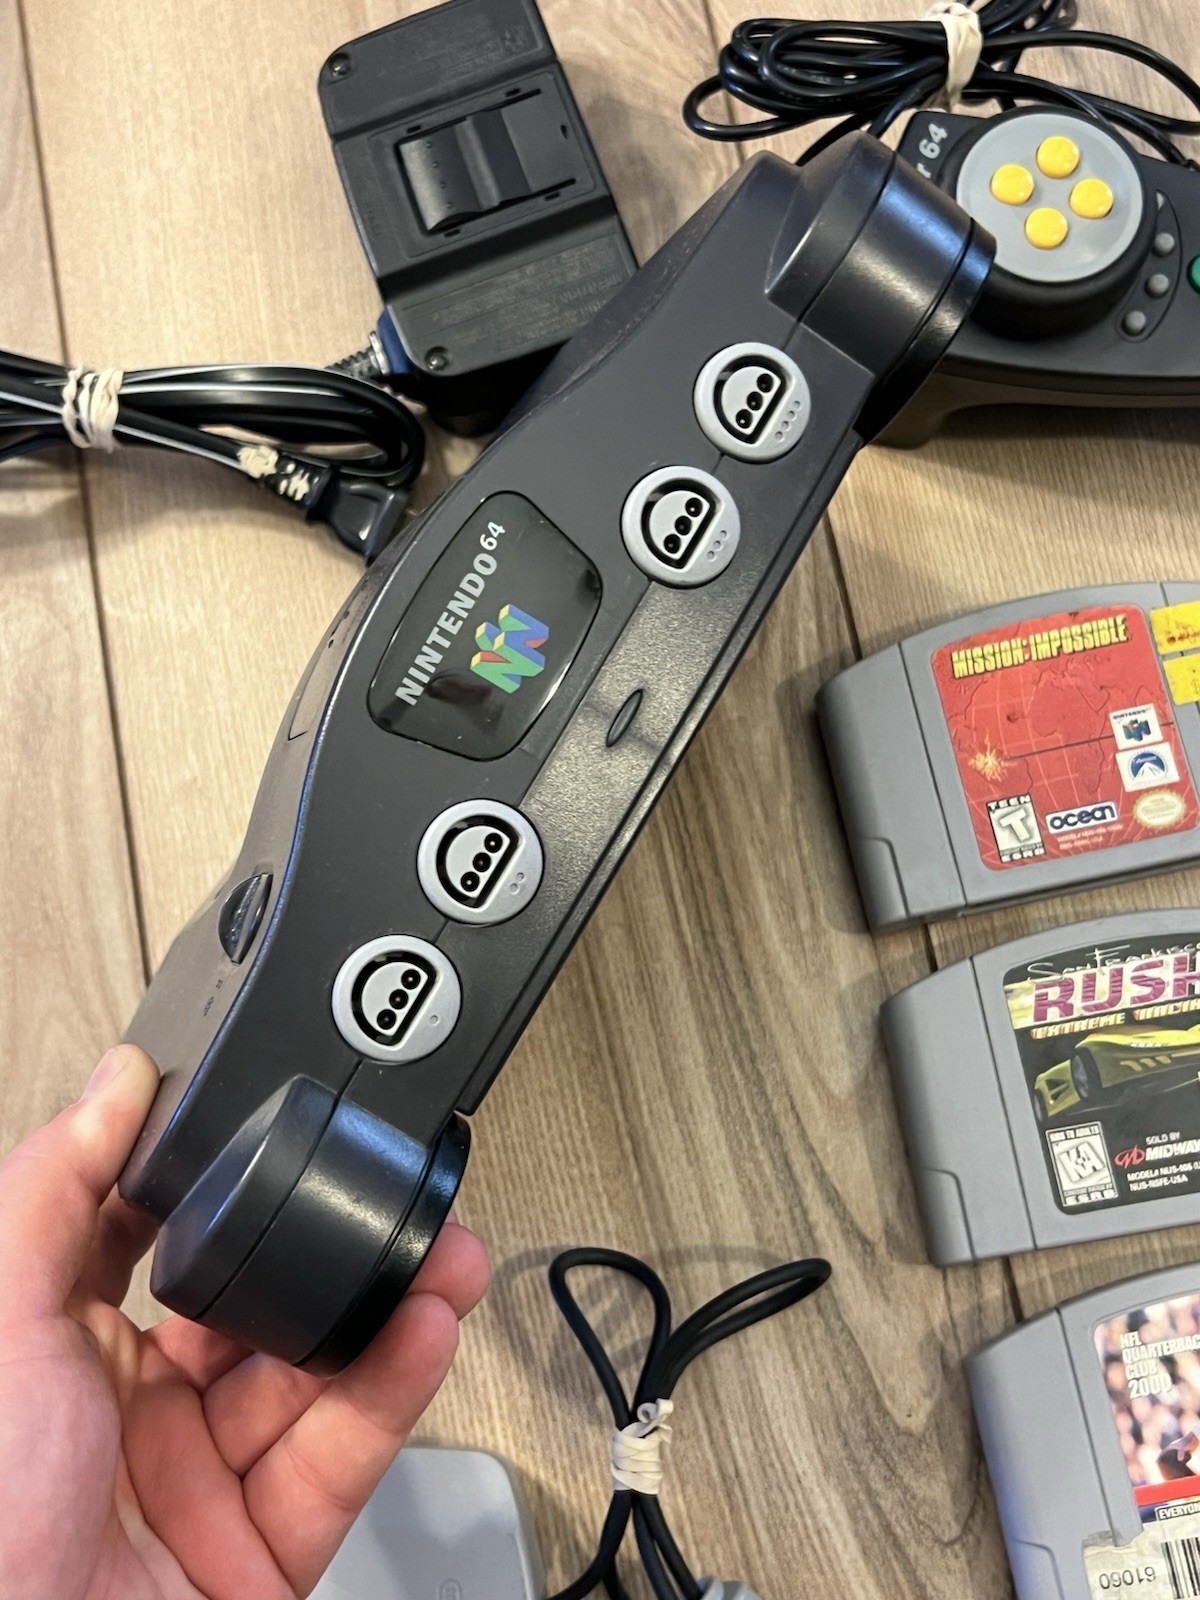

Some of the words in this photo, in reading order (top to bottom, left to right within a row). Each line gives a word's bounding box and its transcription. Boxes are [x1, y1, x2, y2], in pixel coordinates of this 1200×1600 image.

[919, 123, 948, 160] 64
[395, 553, 498, 706] NINTENDO
[479, 521, 506, 551] 64
[951, 636, 1030, 679] MISSION:
[1029, 614, 1129, 661] IMPOSSIBLE
[999, 808, 1027, 841] T
[1049, 805, 1115, 830] ocean
[1033, 954, 1200, 1023] RUSH
[1030, 1012, 1126, 1040] EXTREME
[1145, 1133, 1168, 1145] SOLD
[1120, 1331, 1143, 1349] NFL
[1125, 1359, 1158, 1380] CLUB
[1128, 1374, 1172, 1399] 2000
[1098, 1566, 1157, 1590] 61060
